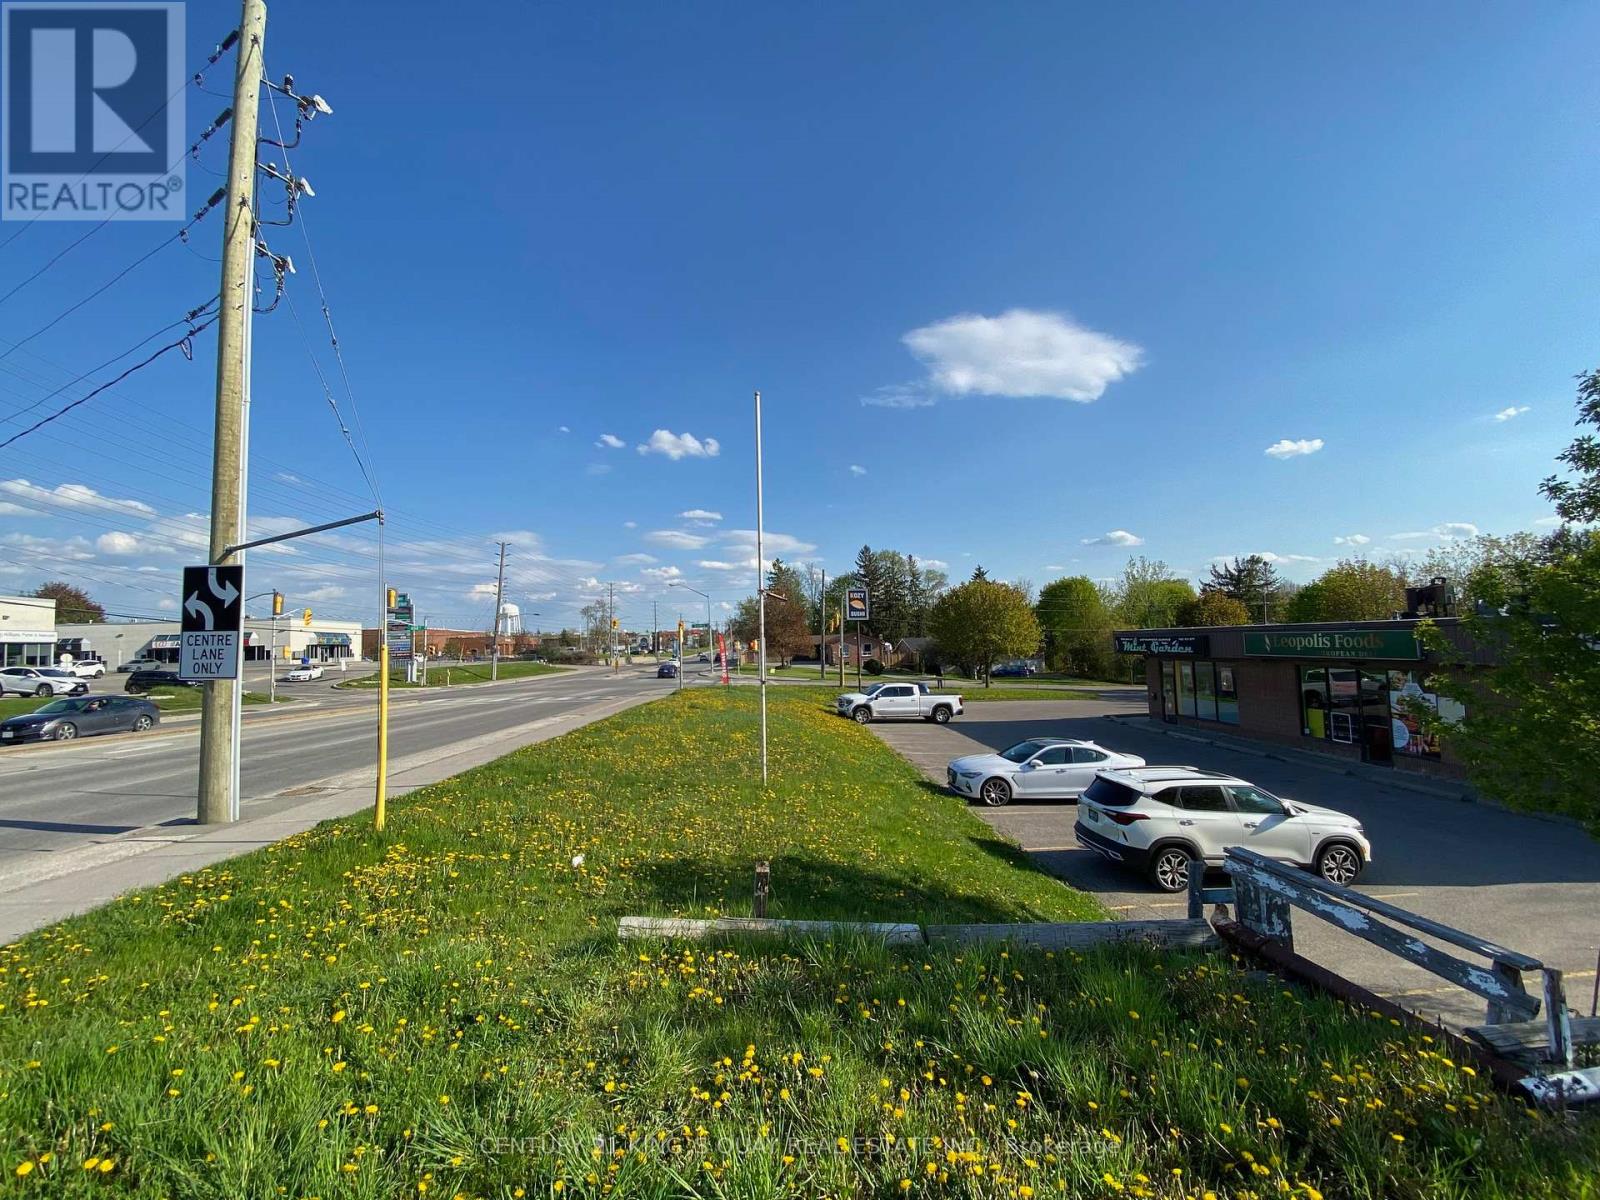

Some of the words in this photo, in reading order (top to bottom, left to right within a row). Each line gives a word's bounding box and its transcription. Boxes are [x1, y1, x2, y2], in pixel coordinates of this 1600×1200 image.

[187, 634, 232, 646] CENTRE
[192, 648, 224, 660] LANE
[193, 662, 222, 674] ONLY
